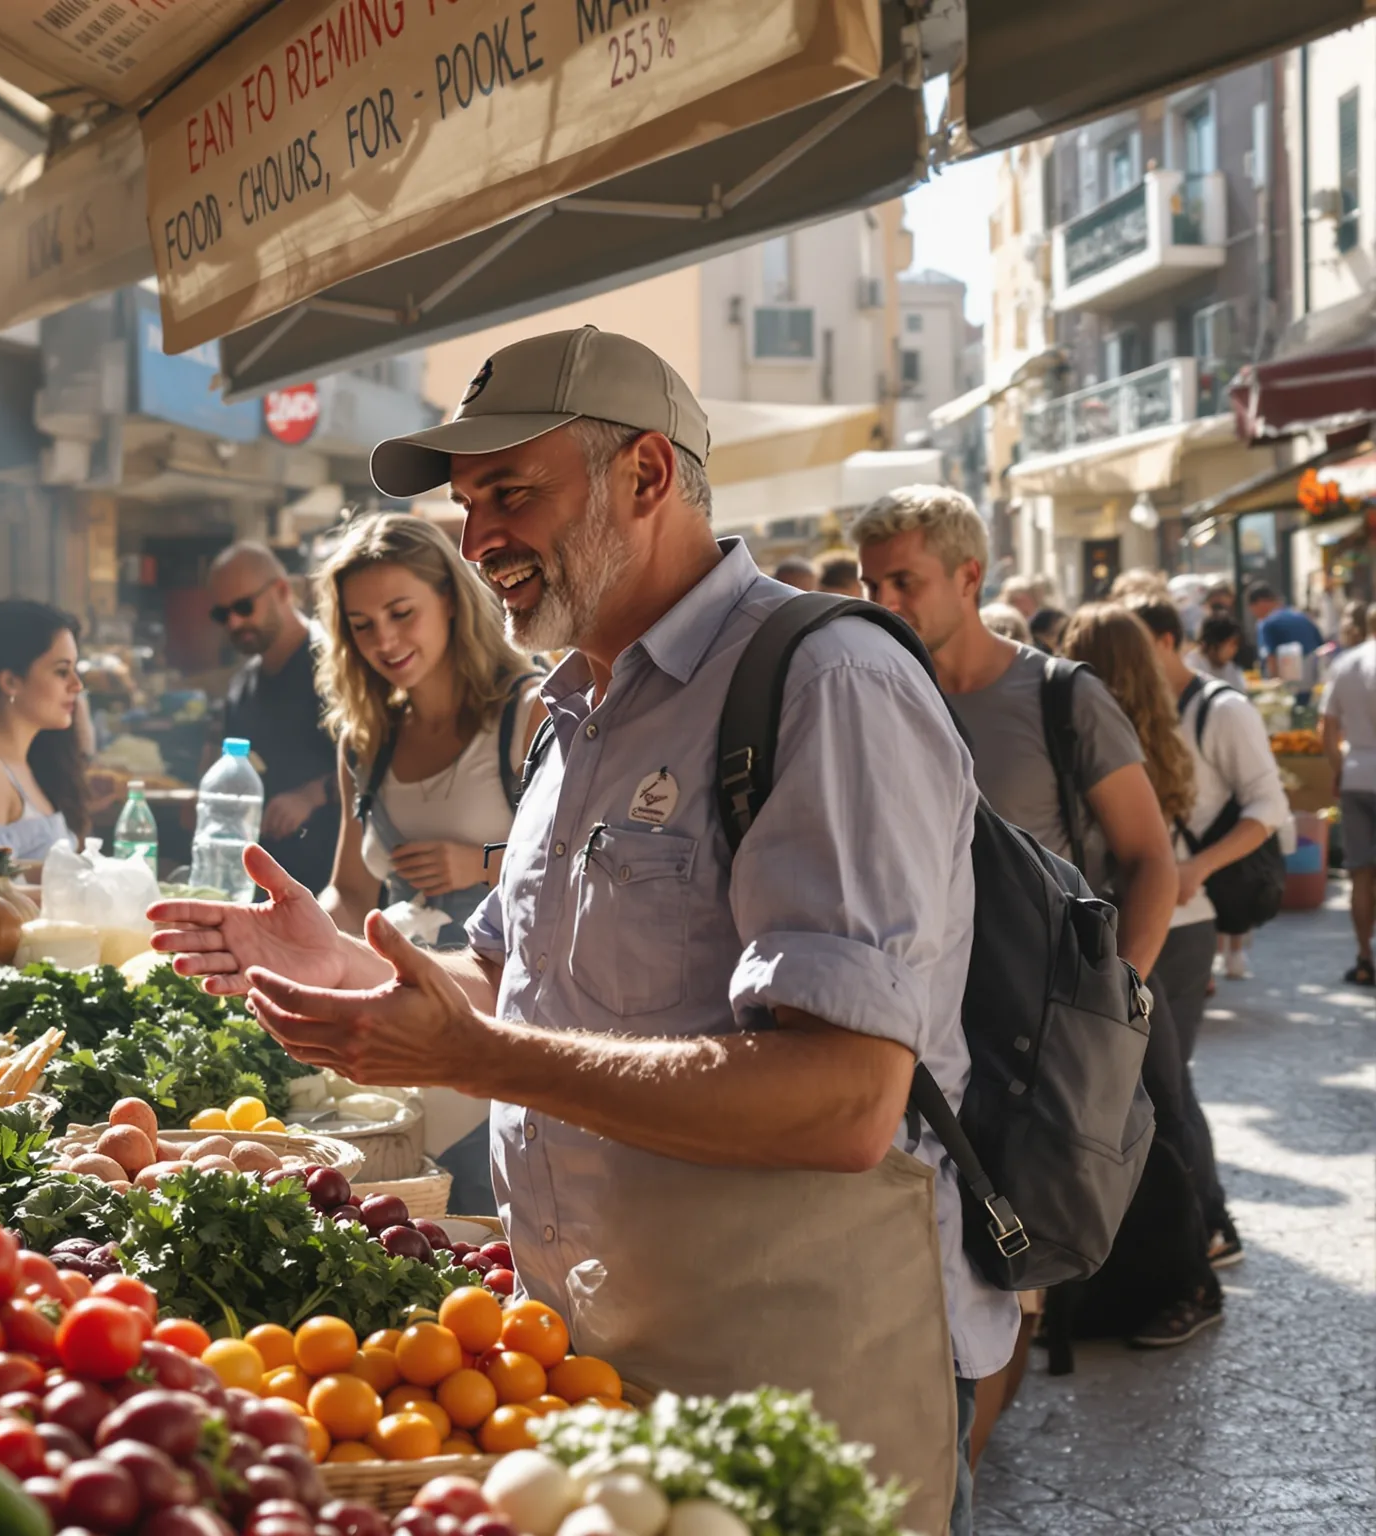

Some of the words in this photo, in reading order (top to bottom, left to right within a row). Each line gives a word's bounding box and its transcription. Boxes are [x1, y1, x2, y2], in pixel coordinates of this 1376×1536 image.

[186, 92, 234, 174] EAN
[239, 130, 331, 226] CHOURS,
[346, 87, 401, 168] FOR
[435, 2, 544, 120] POOKE
